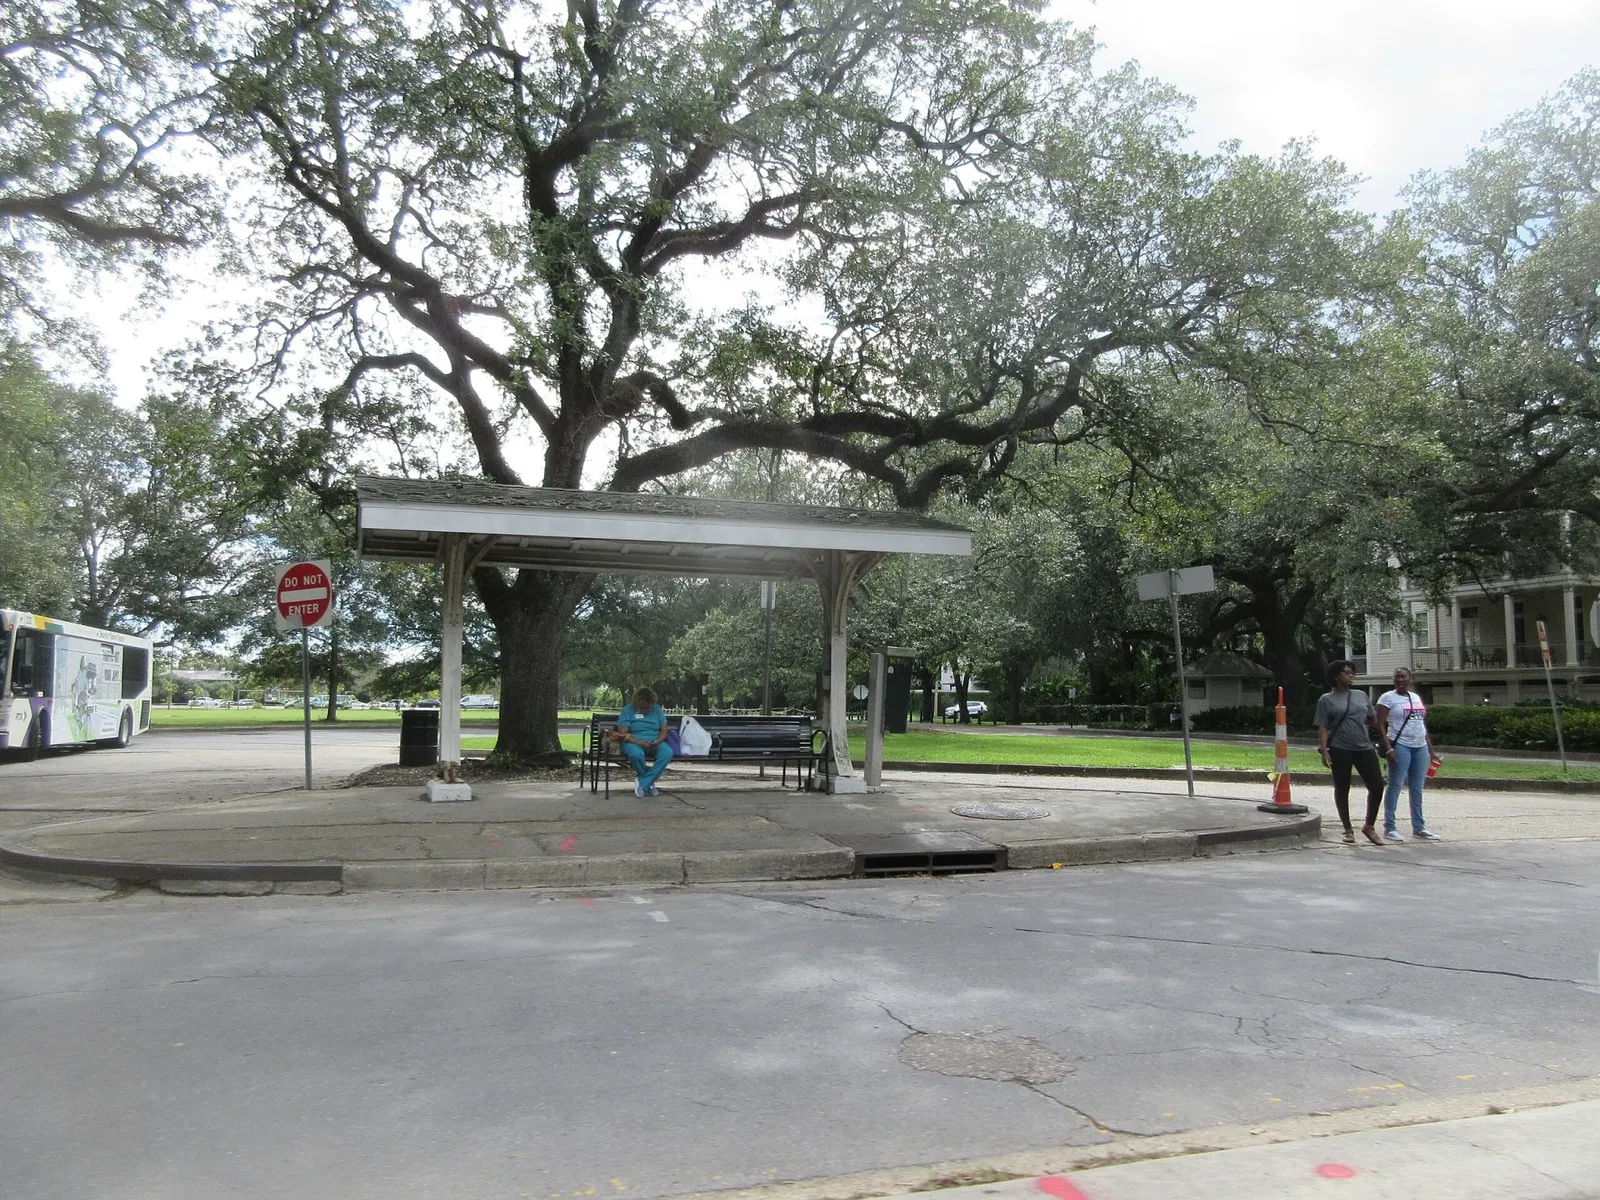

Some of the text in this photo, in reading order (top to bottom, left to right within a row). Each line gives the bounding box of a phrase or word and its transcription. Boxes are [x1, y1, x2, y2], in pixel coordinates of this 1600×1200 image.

[285, 574, 322, 588] DO NOT
[289, 603, 319, 616] ENTER
